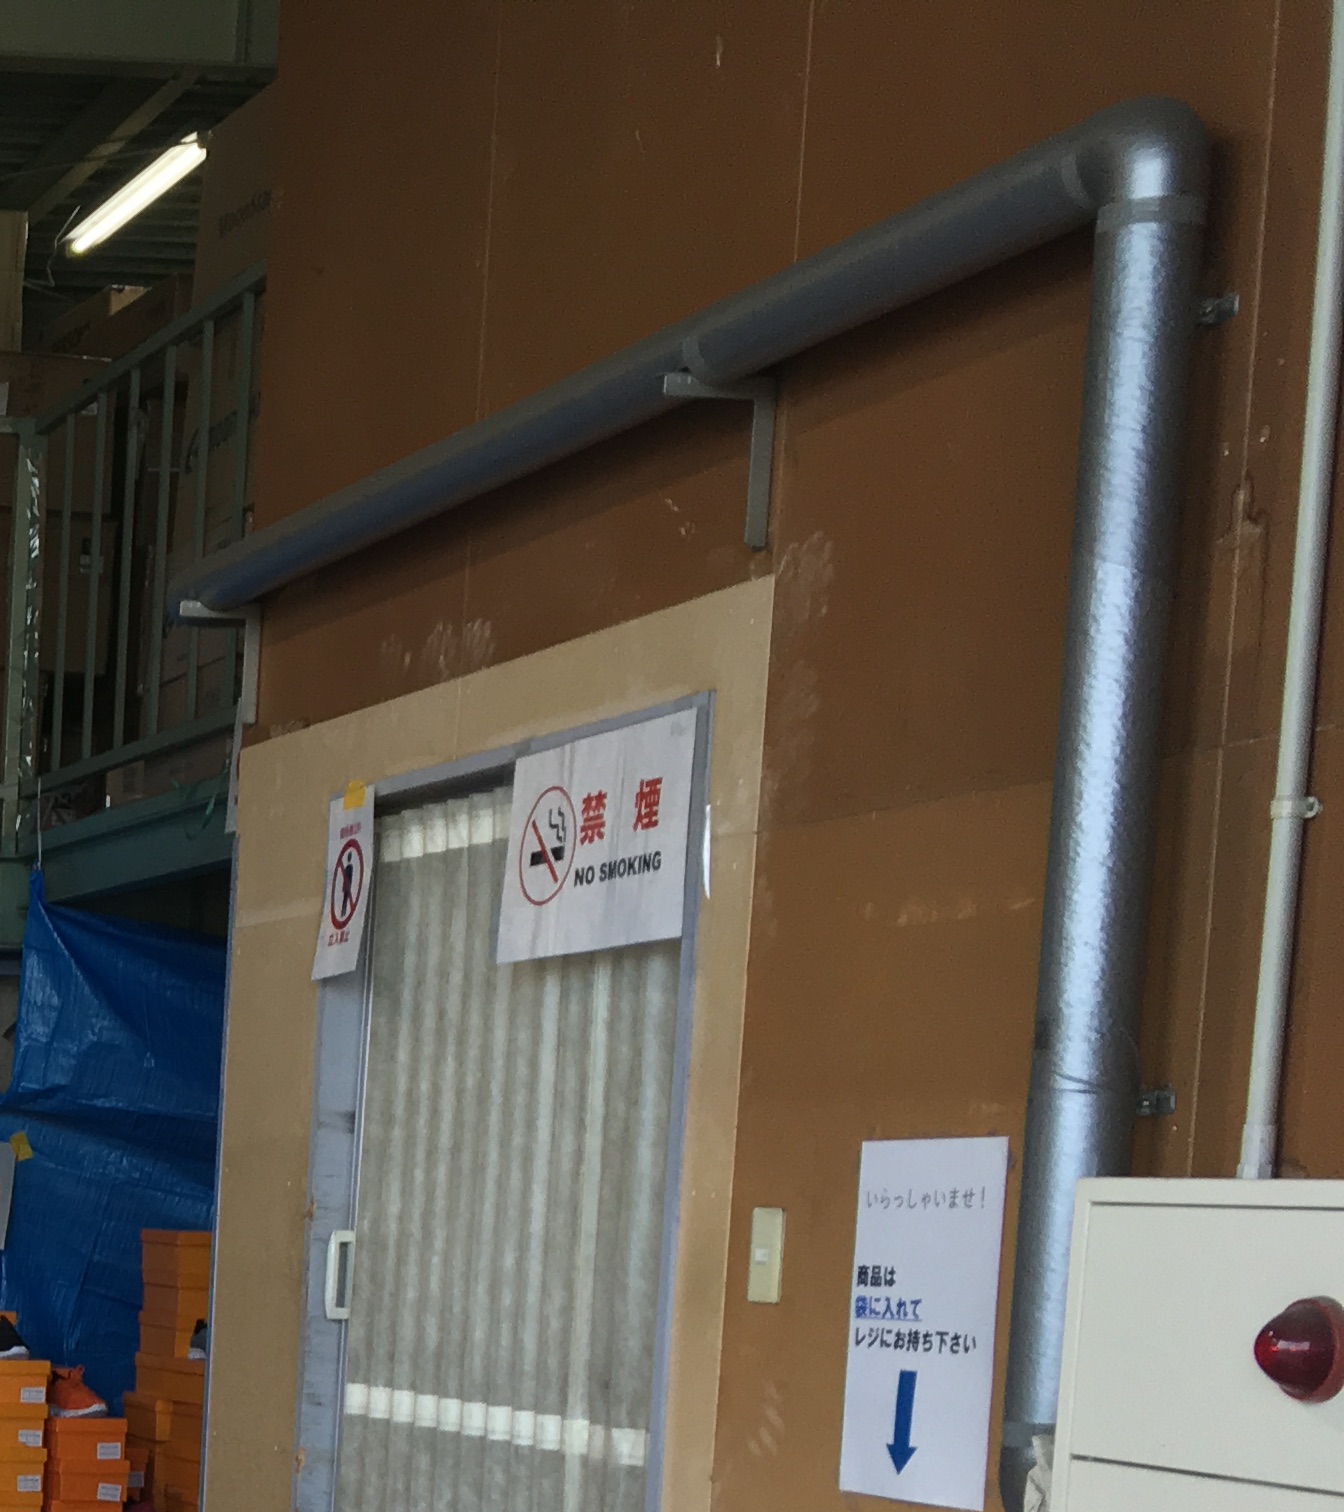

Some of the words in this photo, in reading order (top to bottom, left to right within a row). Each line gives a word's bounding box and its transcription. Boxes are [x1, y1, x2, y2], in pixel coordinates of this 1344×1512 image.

[579, 777, 663, 845] 禁煙
[573, 865, 595, 887] NO
[599, 850, 662, 882] SMOKING
[856, 1264, 897, 1288] 商品は
[854, 1295, 923, 1321] 袋に入れて
[853, 1327, 978, 1355] レジにお持ち下さい
